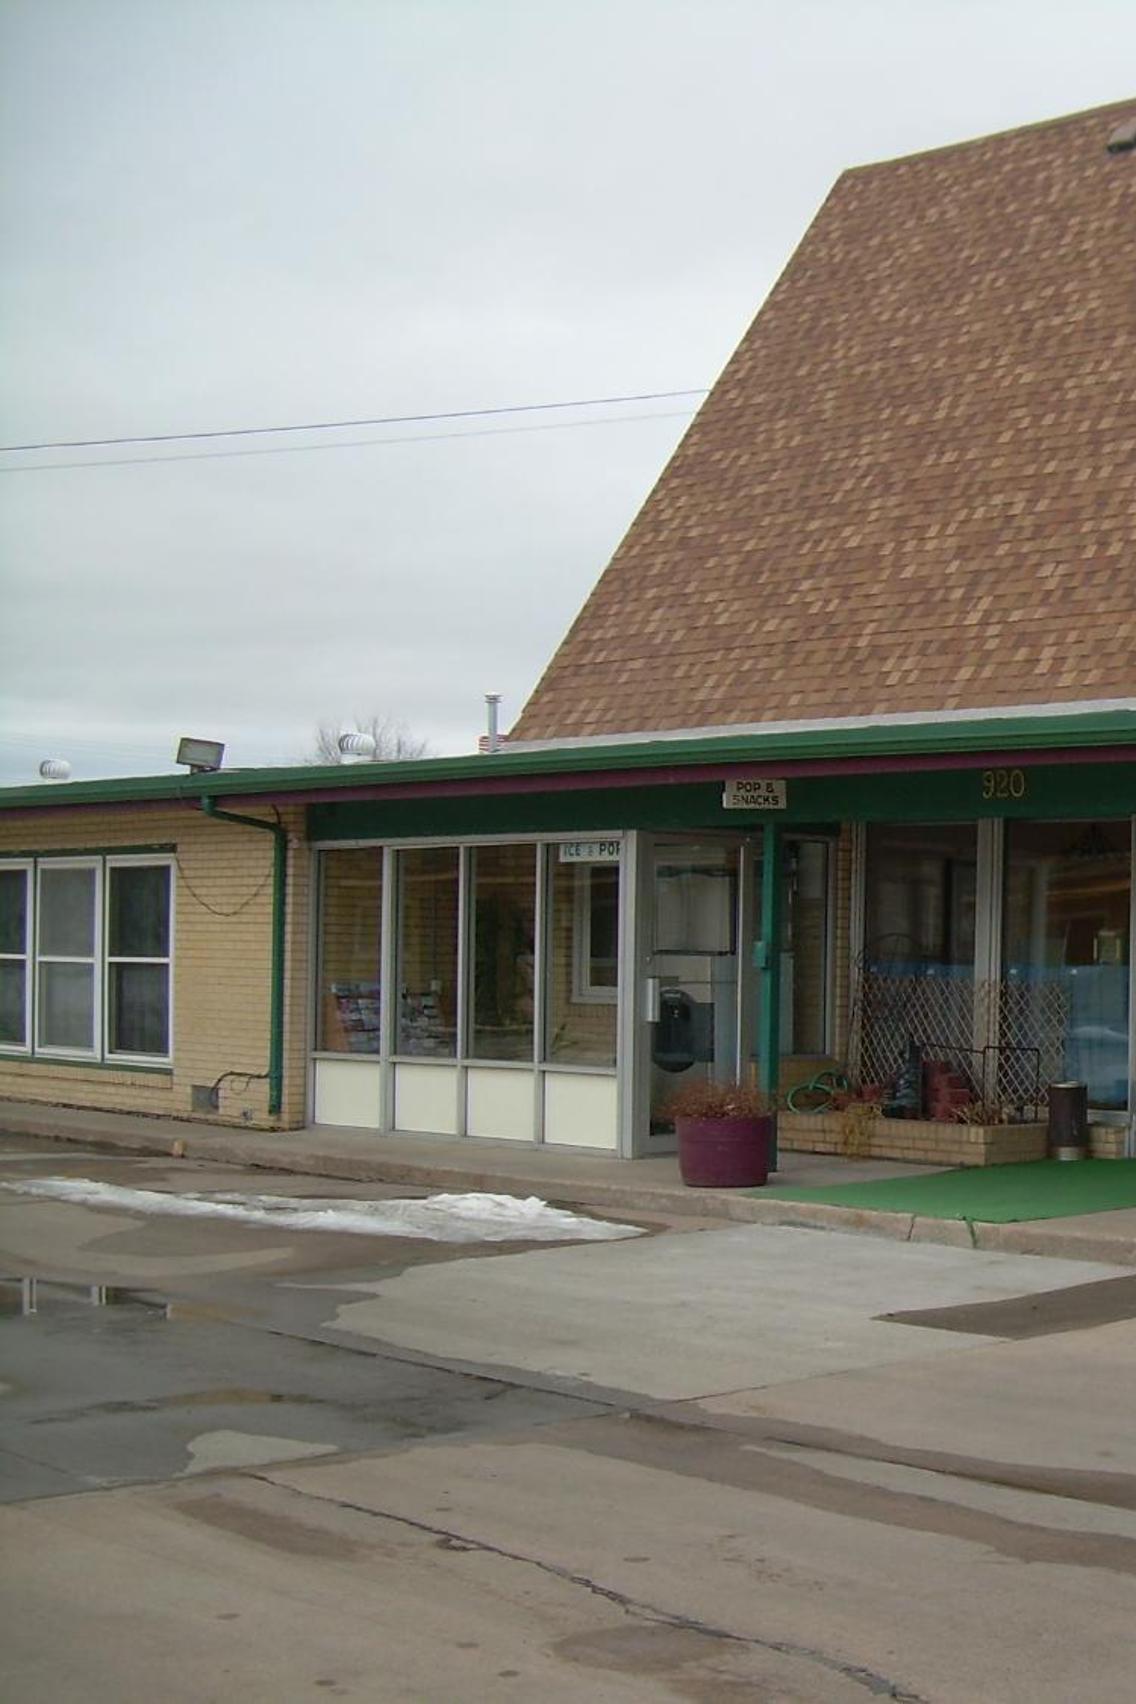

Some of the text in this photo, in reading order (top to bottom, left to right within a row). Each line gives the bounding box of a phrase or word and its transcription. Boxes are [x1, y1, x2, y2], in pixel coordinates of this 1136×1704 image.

[736, 781, 761, 793] POP
[982, 769, 1025, 799] 920
[732, 794, 779, 806] SNACKS
[564, 843, 581, 857] ICE
